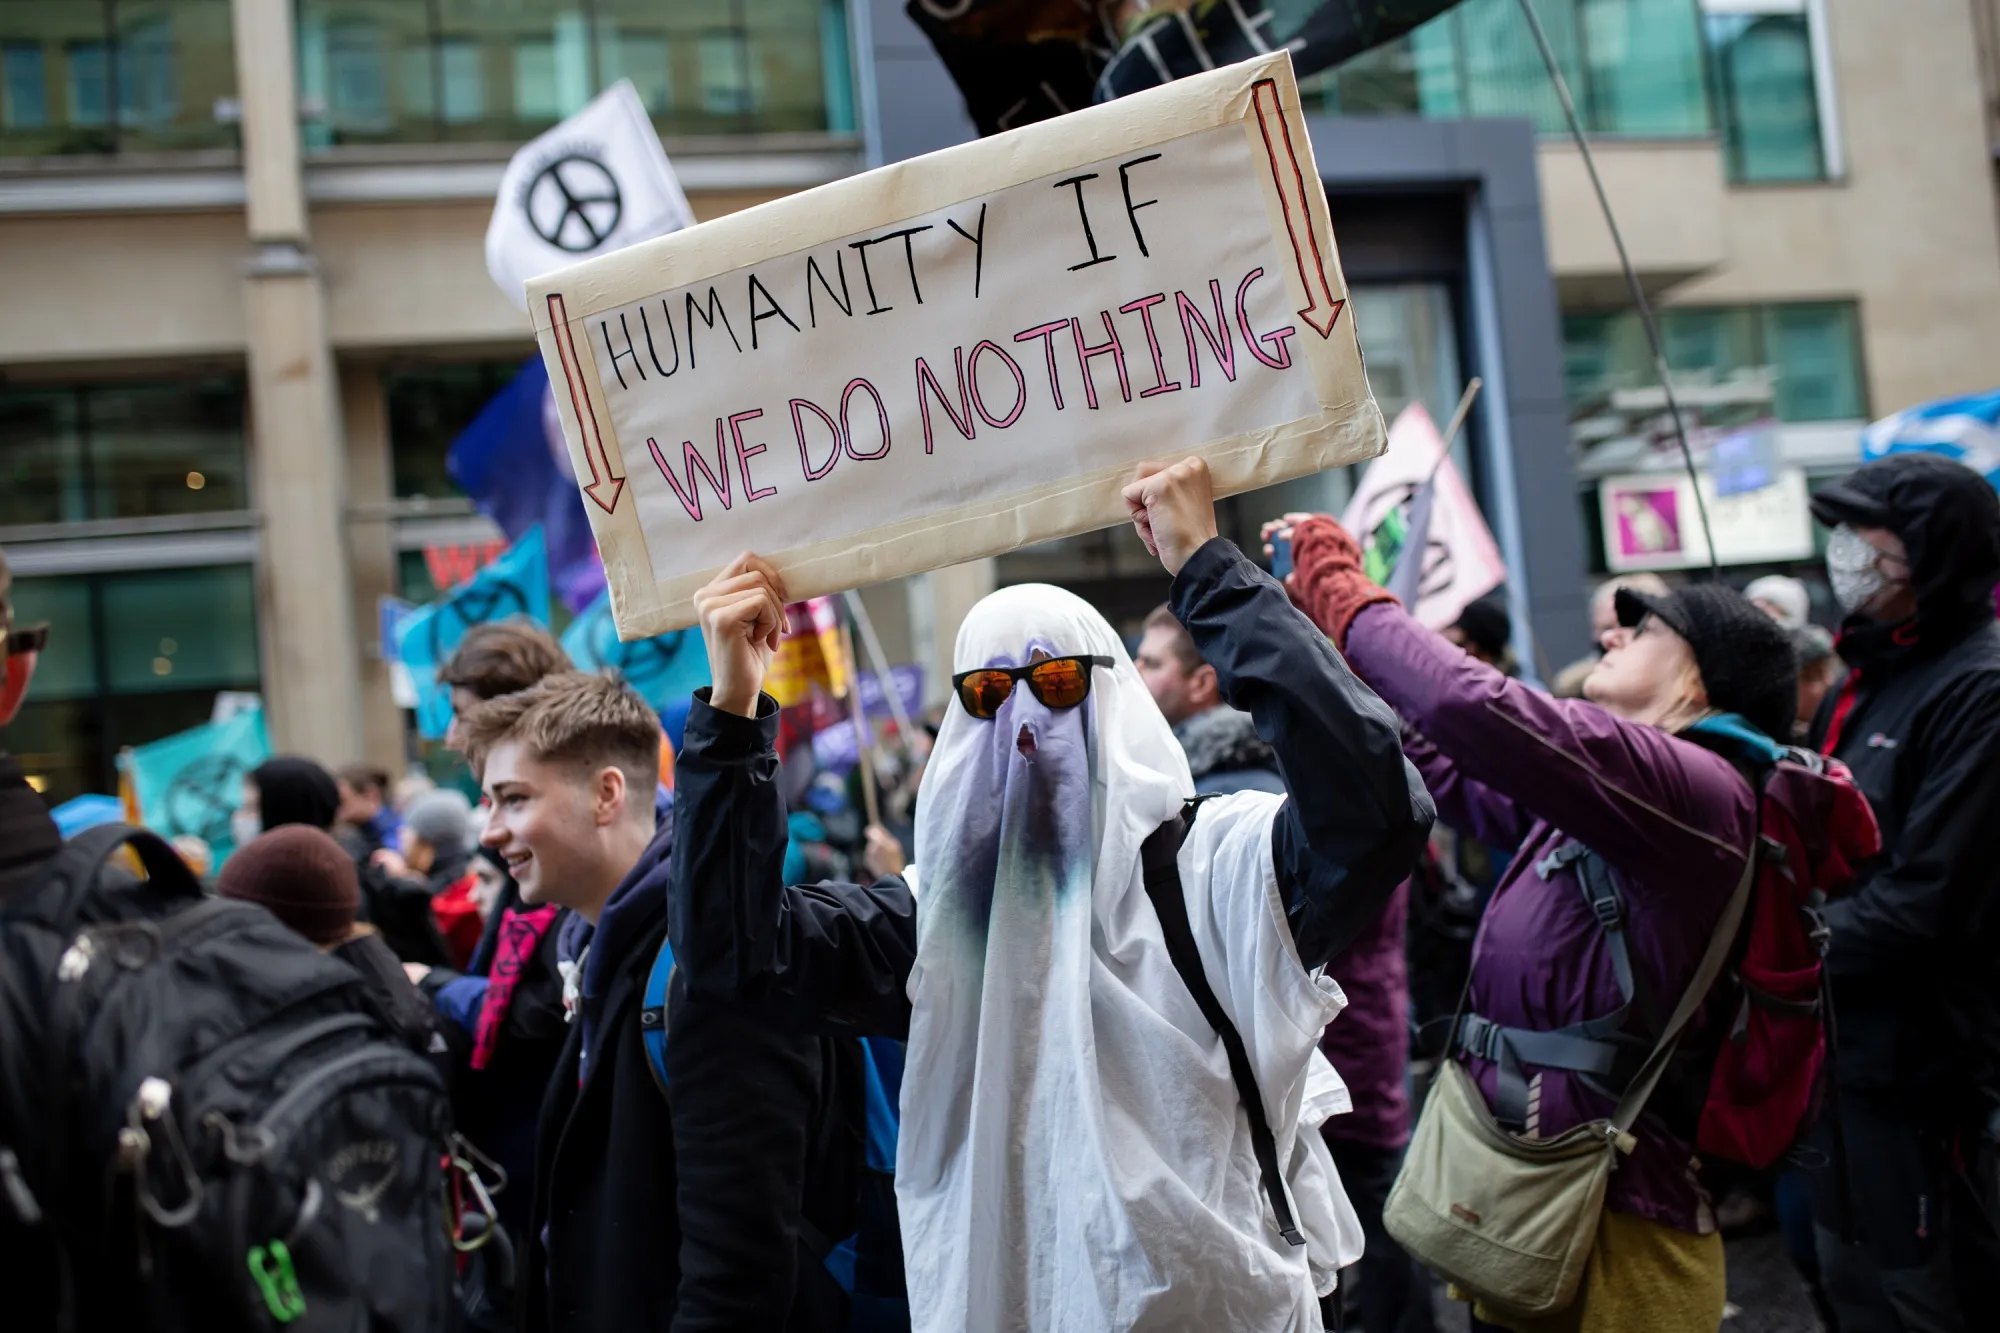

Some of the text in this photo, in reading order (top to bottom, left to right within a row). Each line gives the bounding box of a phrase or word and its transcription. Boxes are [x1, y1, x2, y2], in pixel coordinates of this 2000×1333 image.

[601, 153, 1162, 389] HUMANITY IF
[647, 267, 1296, 521] WE DO NOTHING
